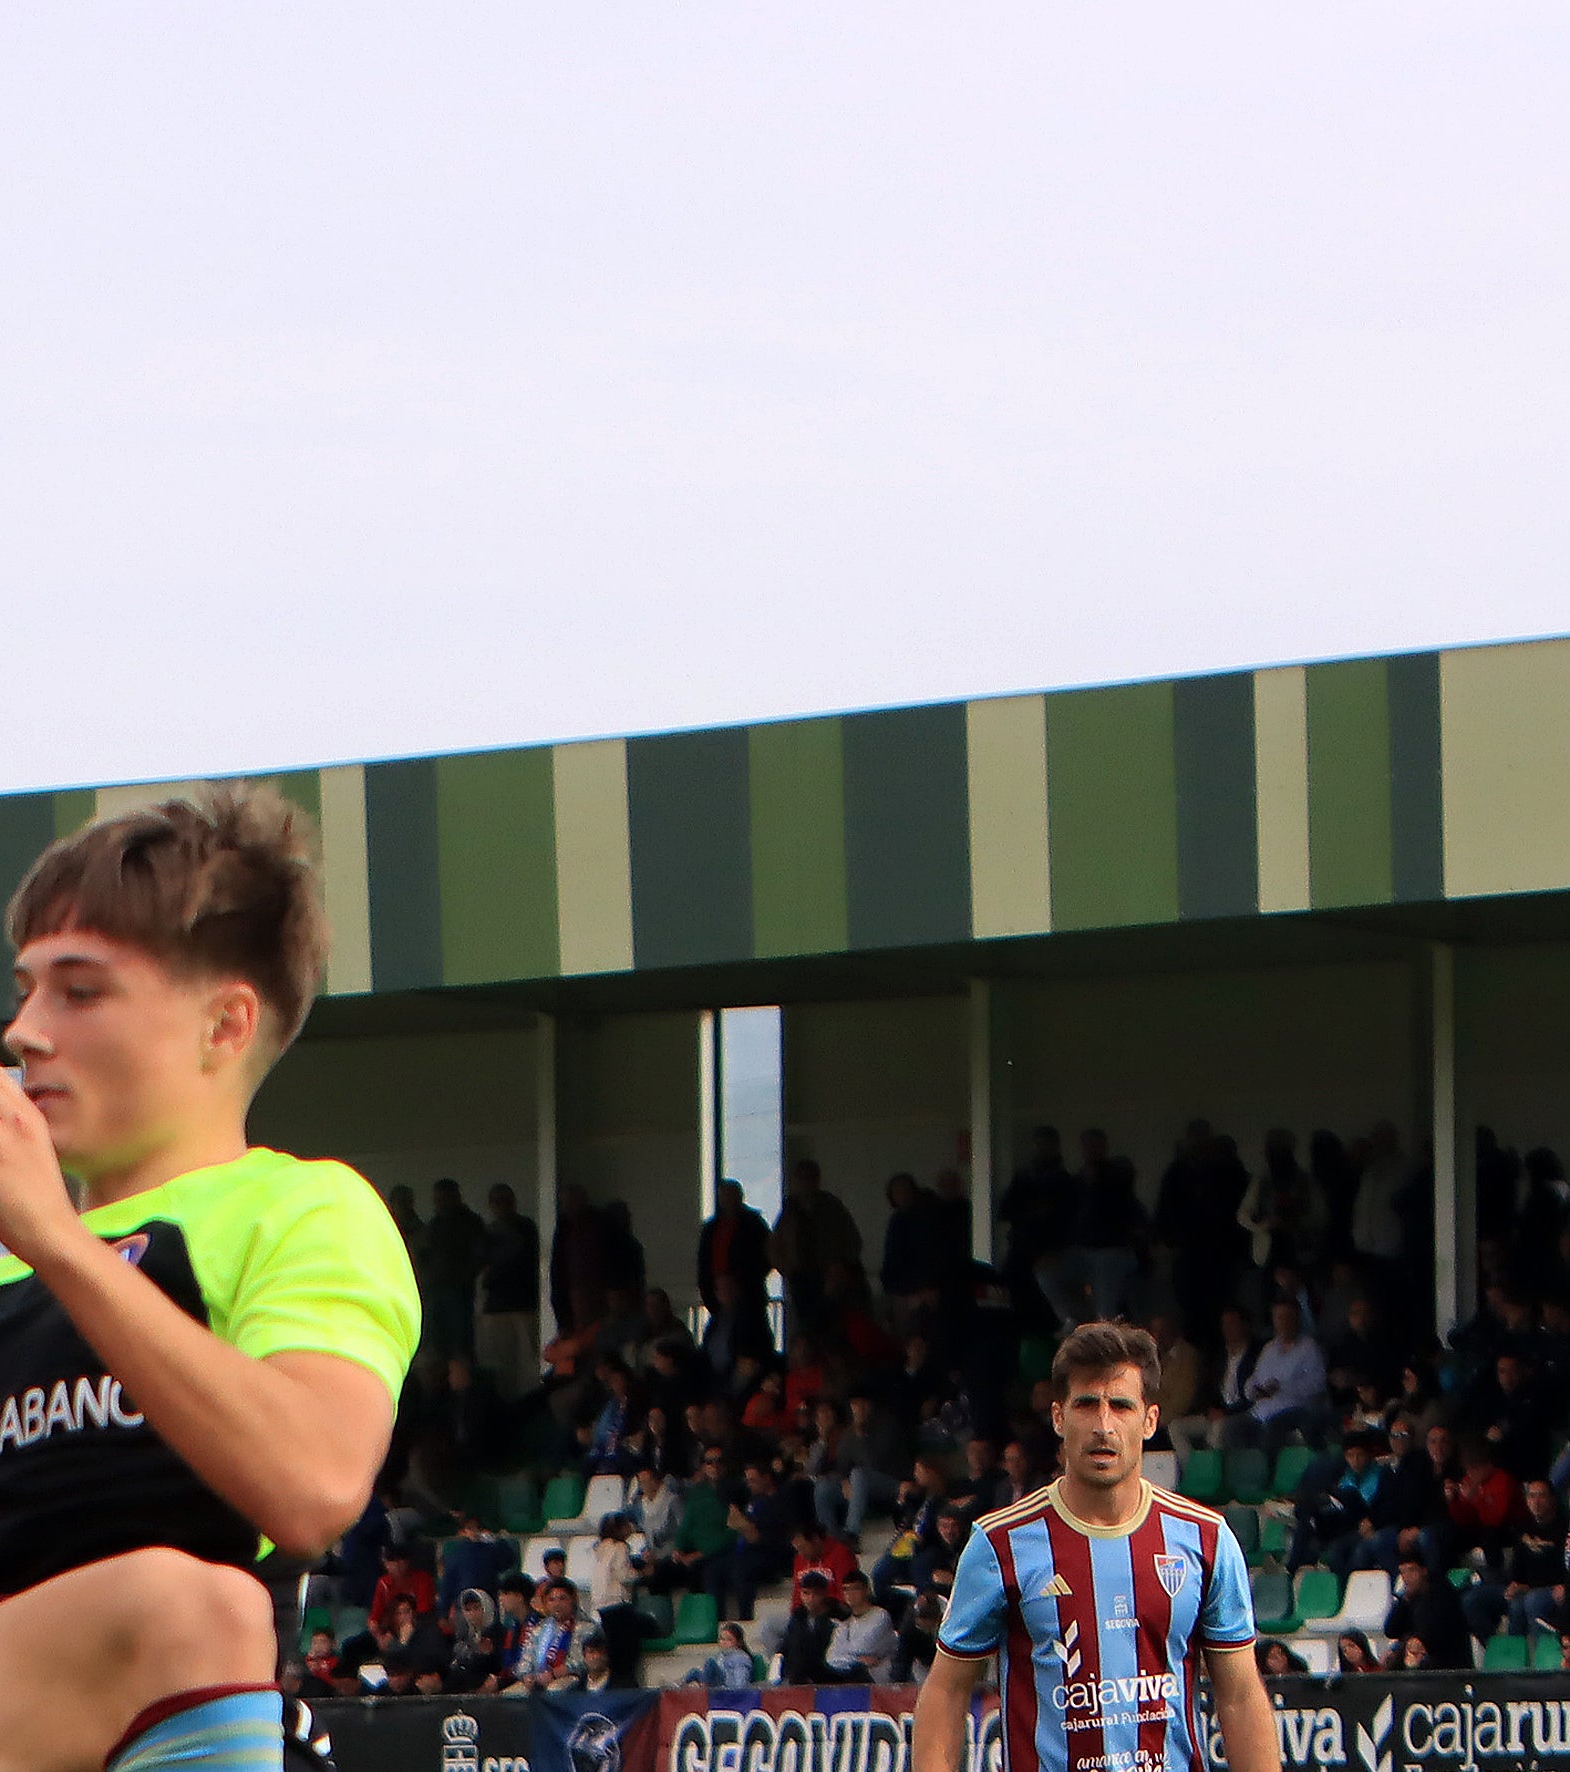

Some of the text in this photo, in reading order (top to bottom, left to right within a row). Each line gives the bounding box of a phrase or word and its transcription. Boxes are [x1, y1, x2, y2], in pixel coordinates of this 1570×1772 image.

[1104, 1617, 1141, 1631] SEGOVIA
[1052, 1669, 1180, 1715] cajaviva
[1060, 1714, 1118, 1732] cajarural
